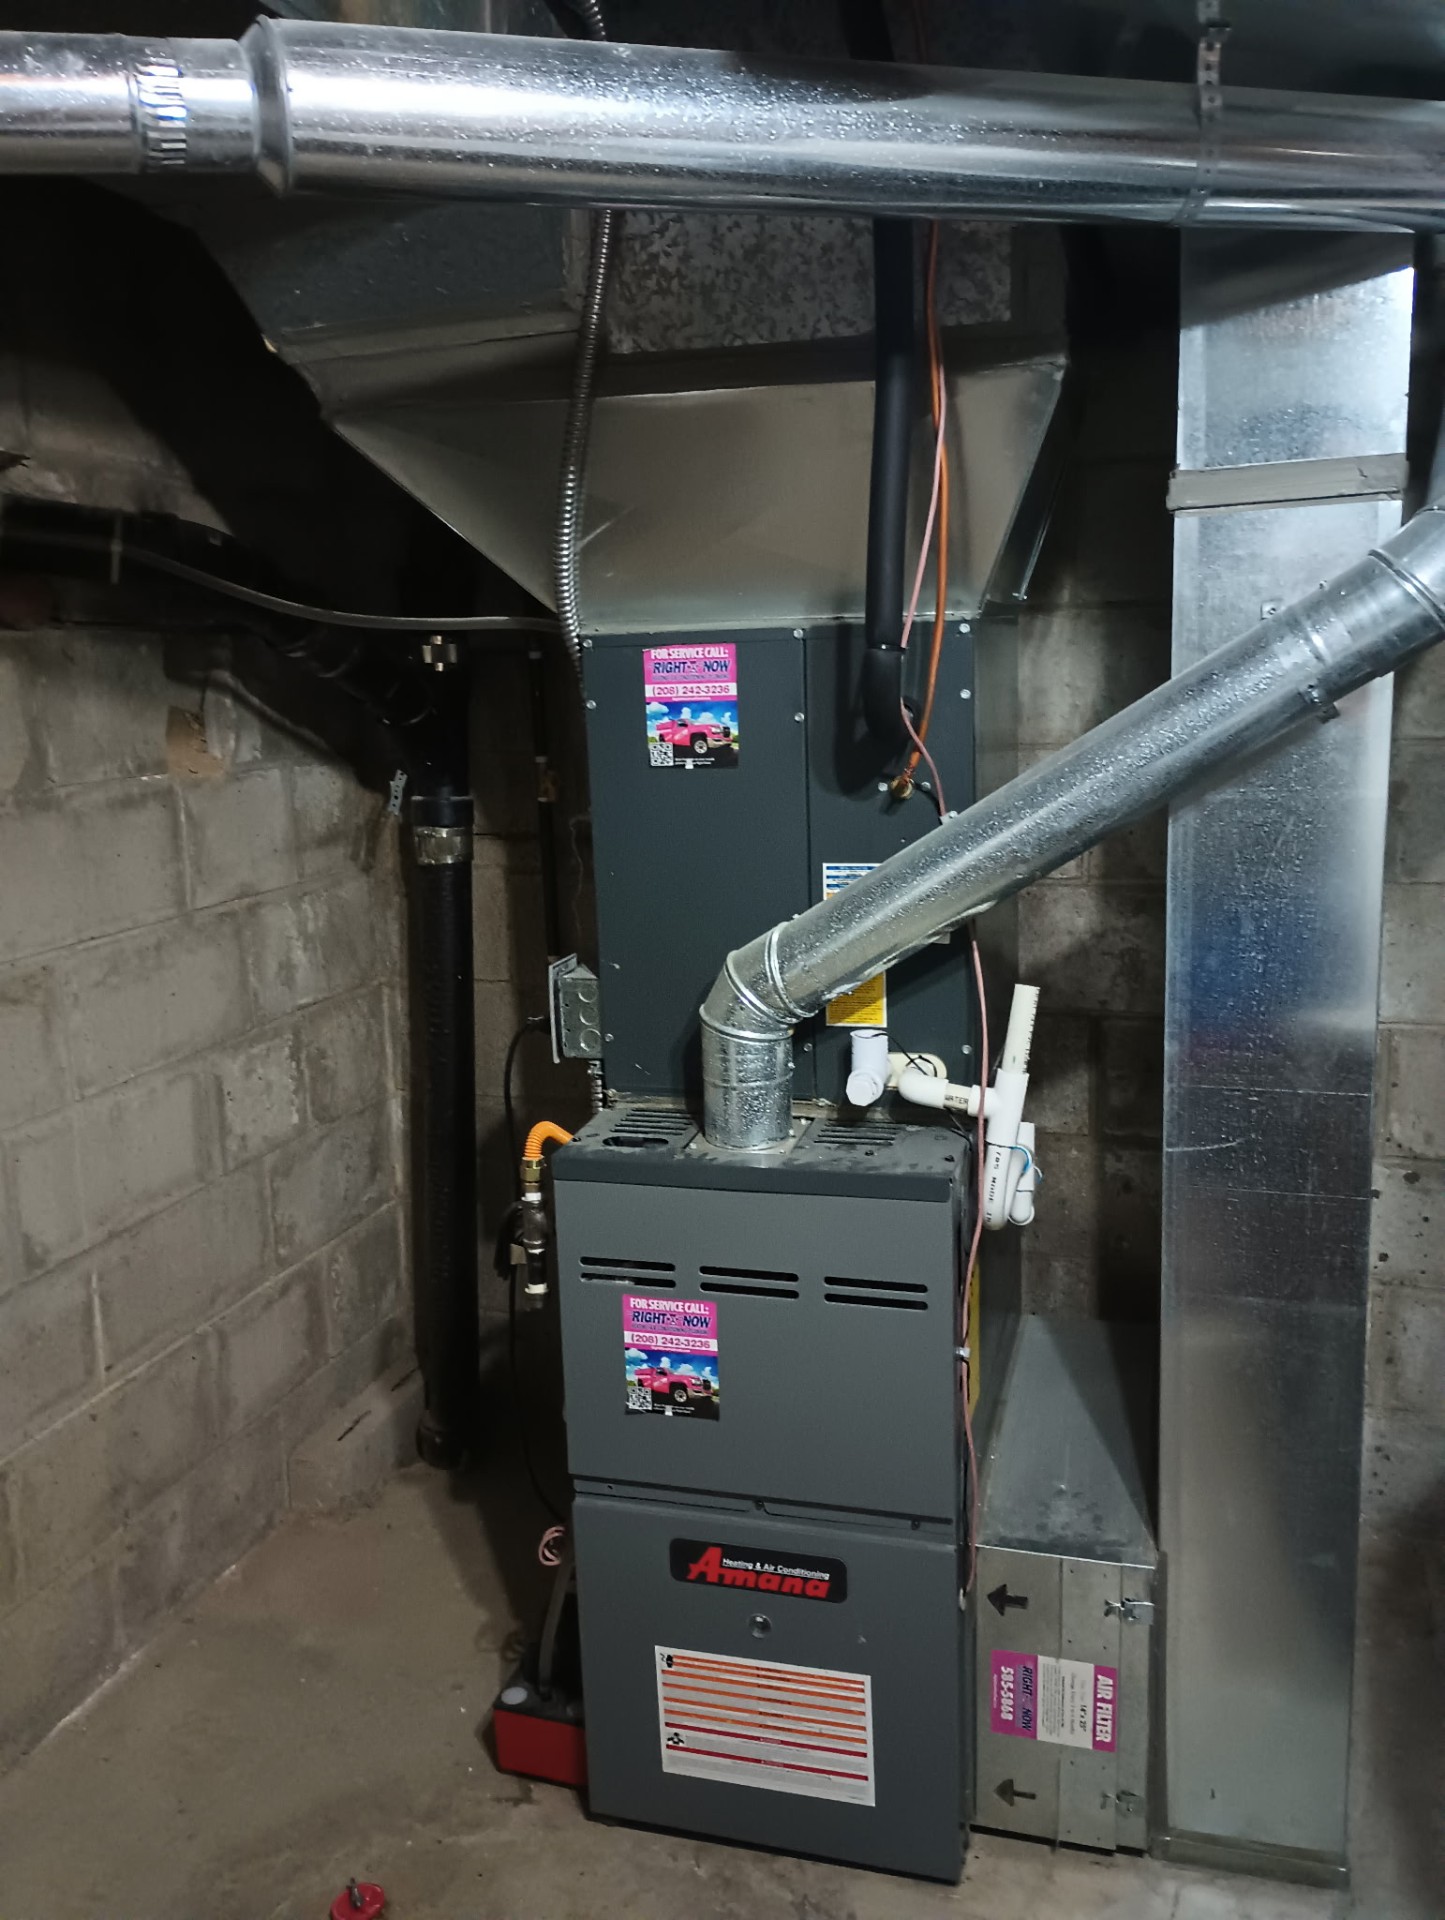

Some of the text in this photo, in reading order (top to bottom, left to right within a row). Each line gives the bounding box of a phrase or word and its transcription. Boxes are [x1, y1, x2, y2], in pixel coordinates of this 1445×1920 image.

[651, 647, 729, 659] FOR SERVICE CALL:
[653, 660, 730, 673] RIGHT NOW
[630, 1297, 709, 1315] FOR SERVICE CALL:
[632, 1311, 711, 1328] RIGHT NOW
[686, 1546, 831, 1599] Amana
[722, 1557, 830, 1581] Heating & Air Conditioning
[1021, 1665, 1033, 1731] RIGHT NOW
[1095, 1674, 1113, 1743] AIR FILTER
